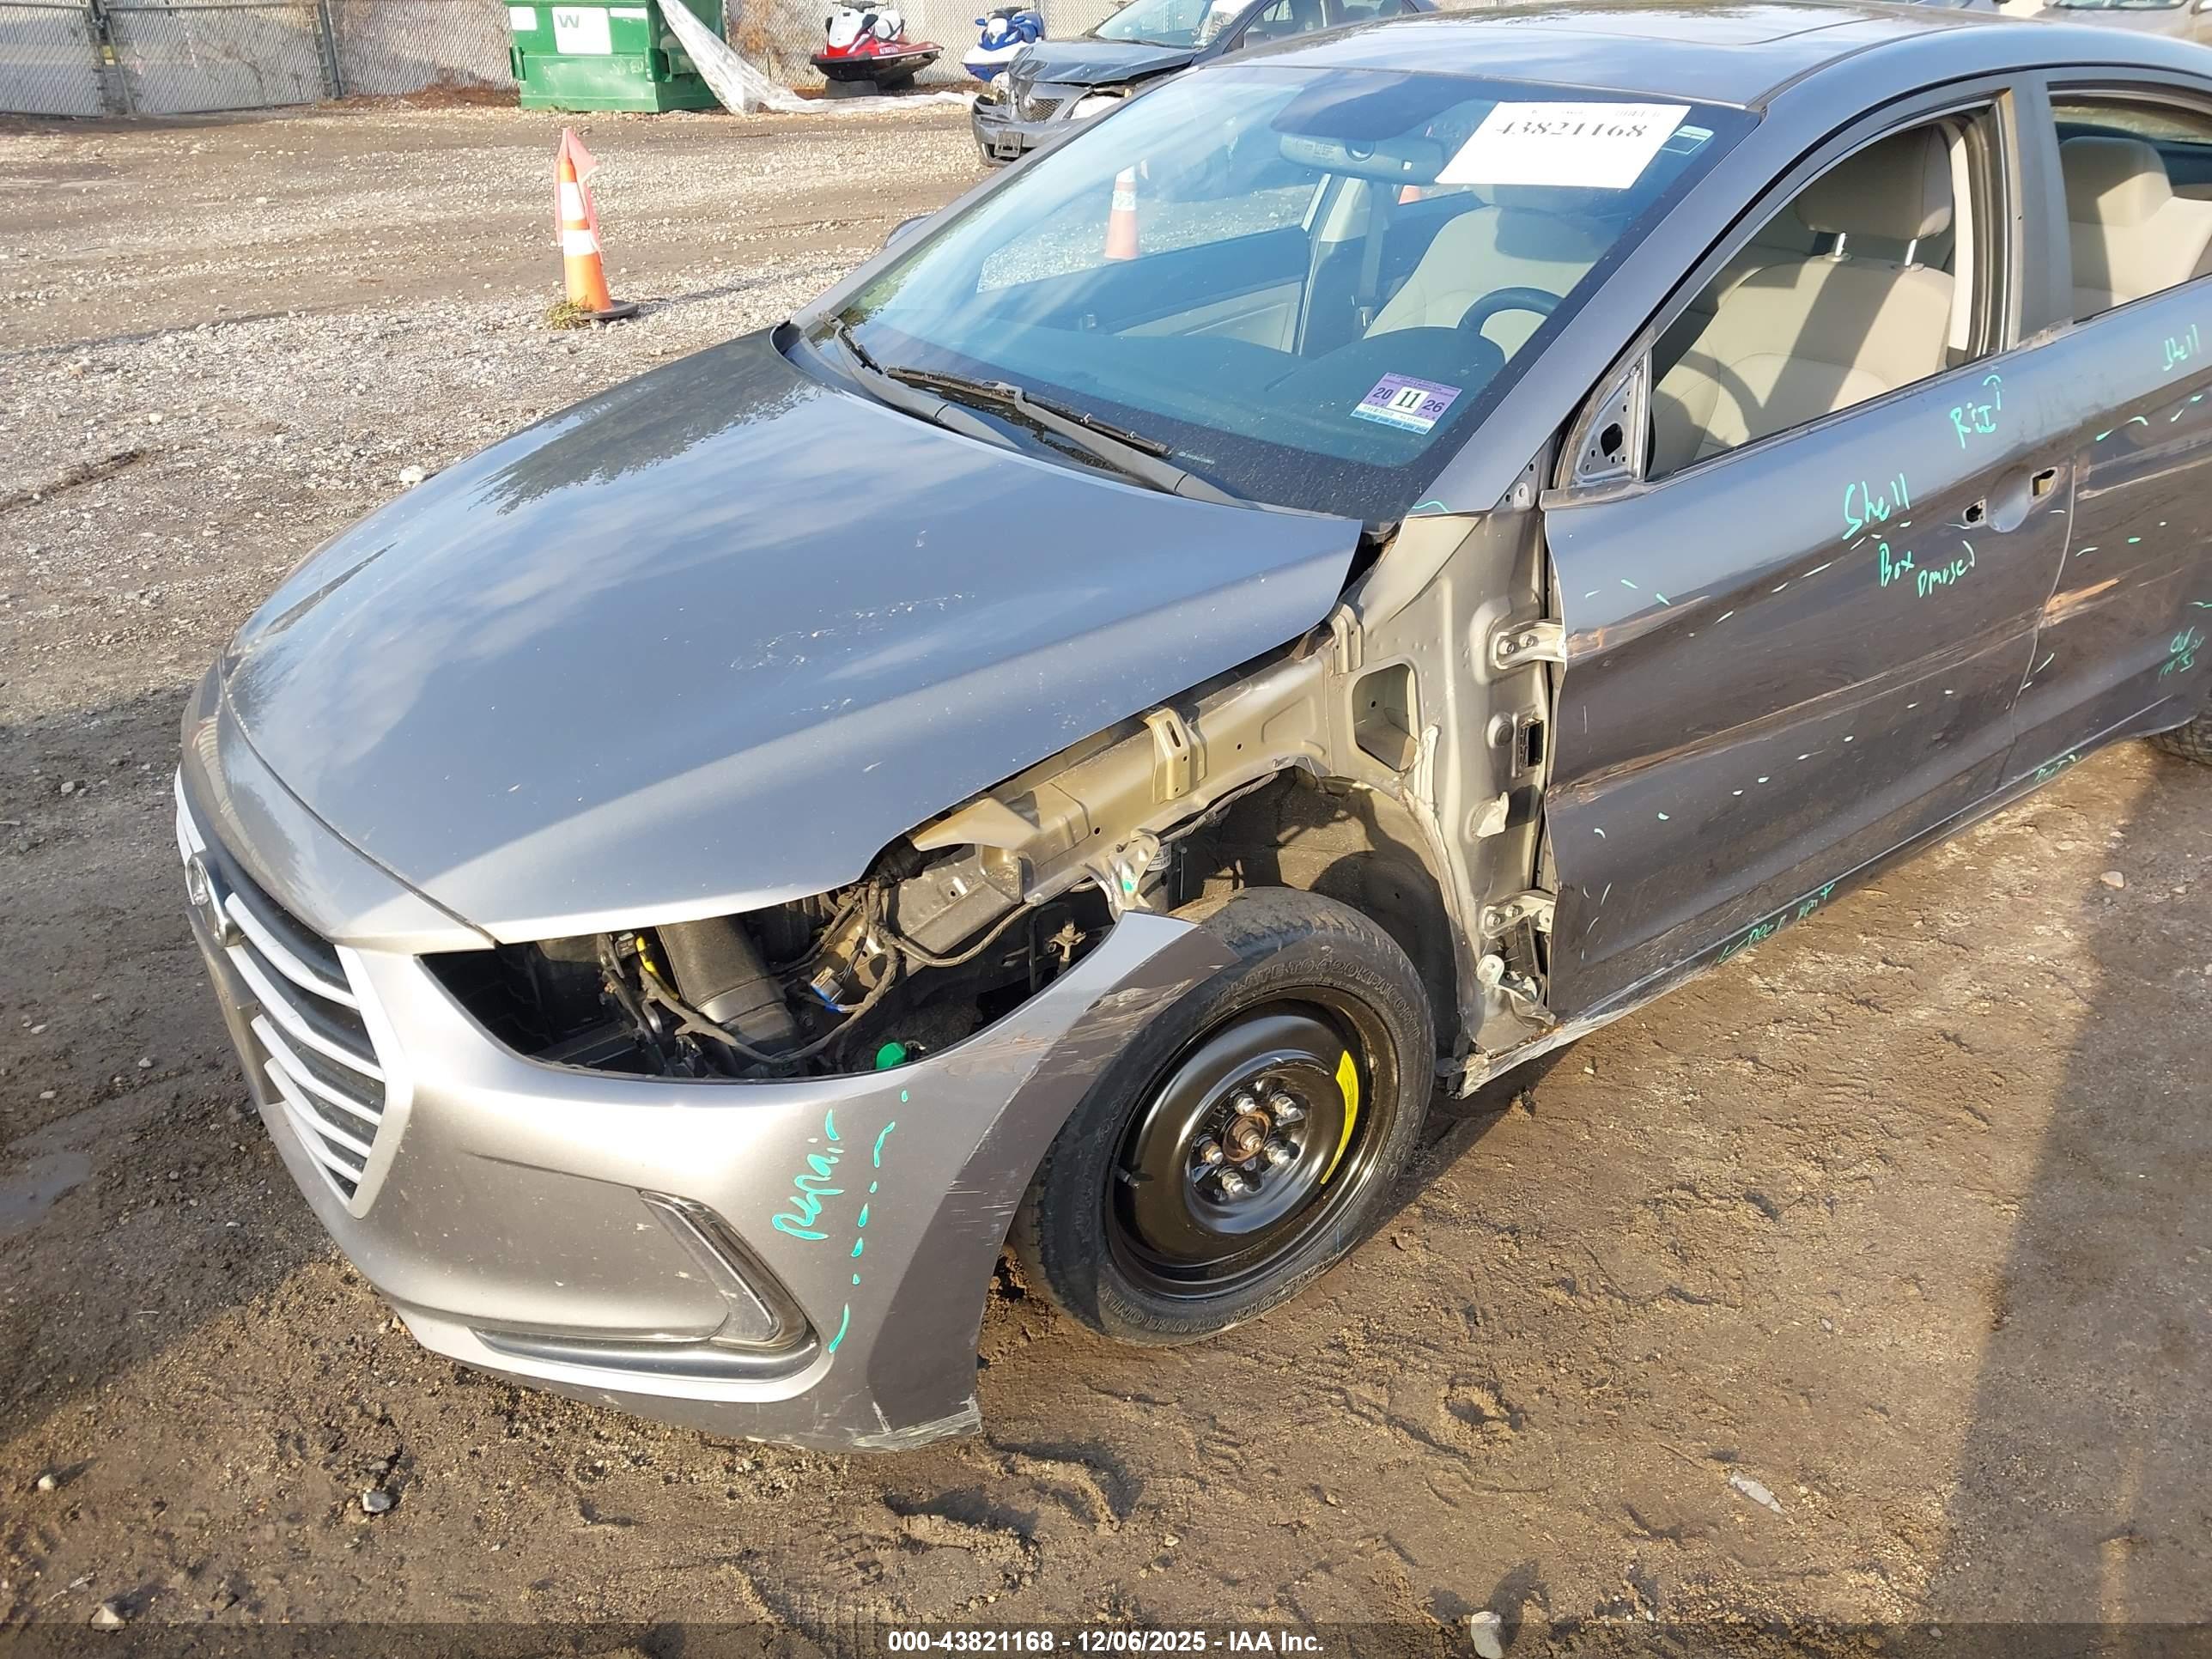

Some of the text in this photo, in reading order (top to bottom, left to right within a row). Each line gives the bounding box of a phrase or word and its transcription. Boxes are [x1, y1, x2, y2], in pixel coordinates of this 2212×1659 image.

[1372, 386, 1445, 413] 20 11 26
[1841, 472, 1911, 540] Shell
[1880, 542, 1915, 588] Box
